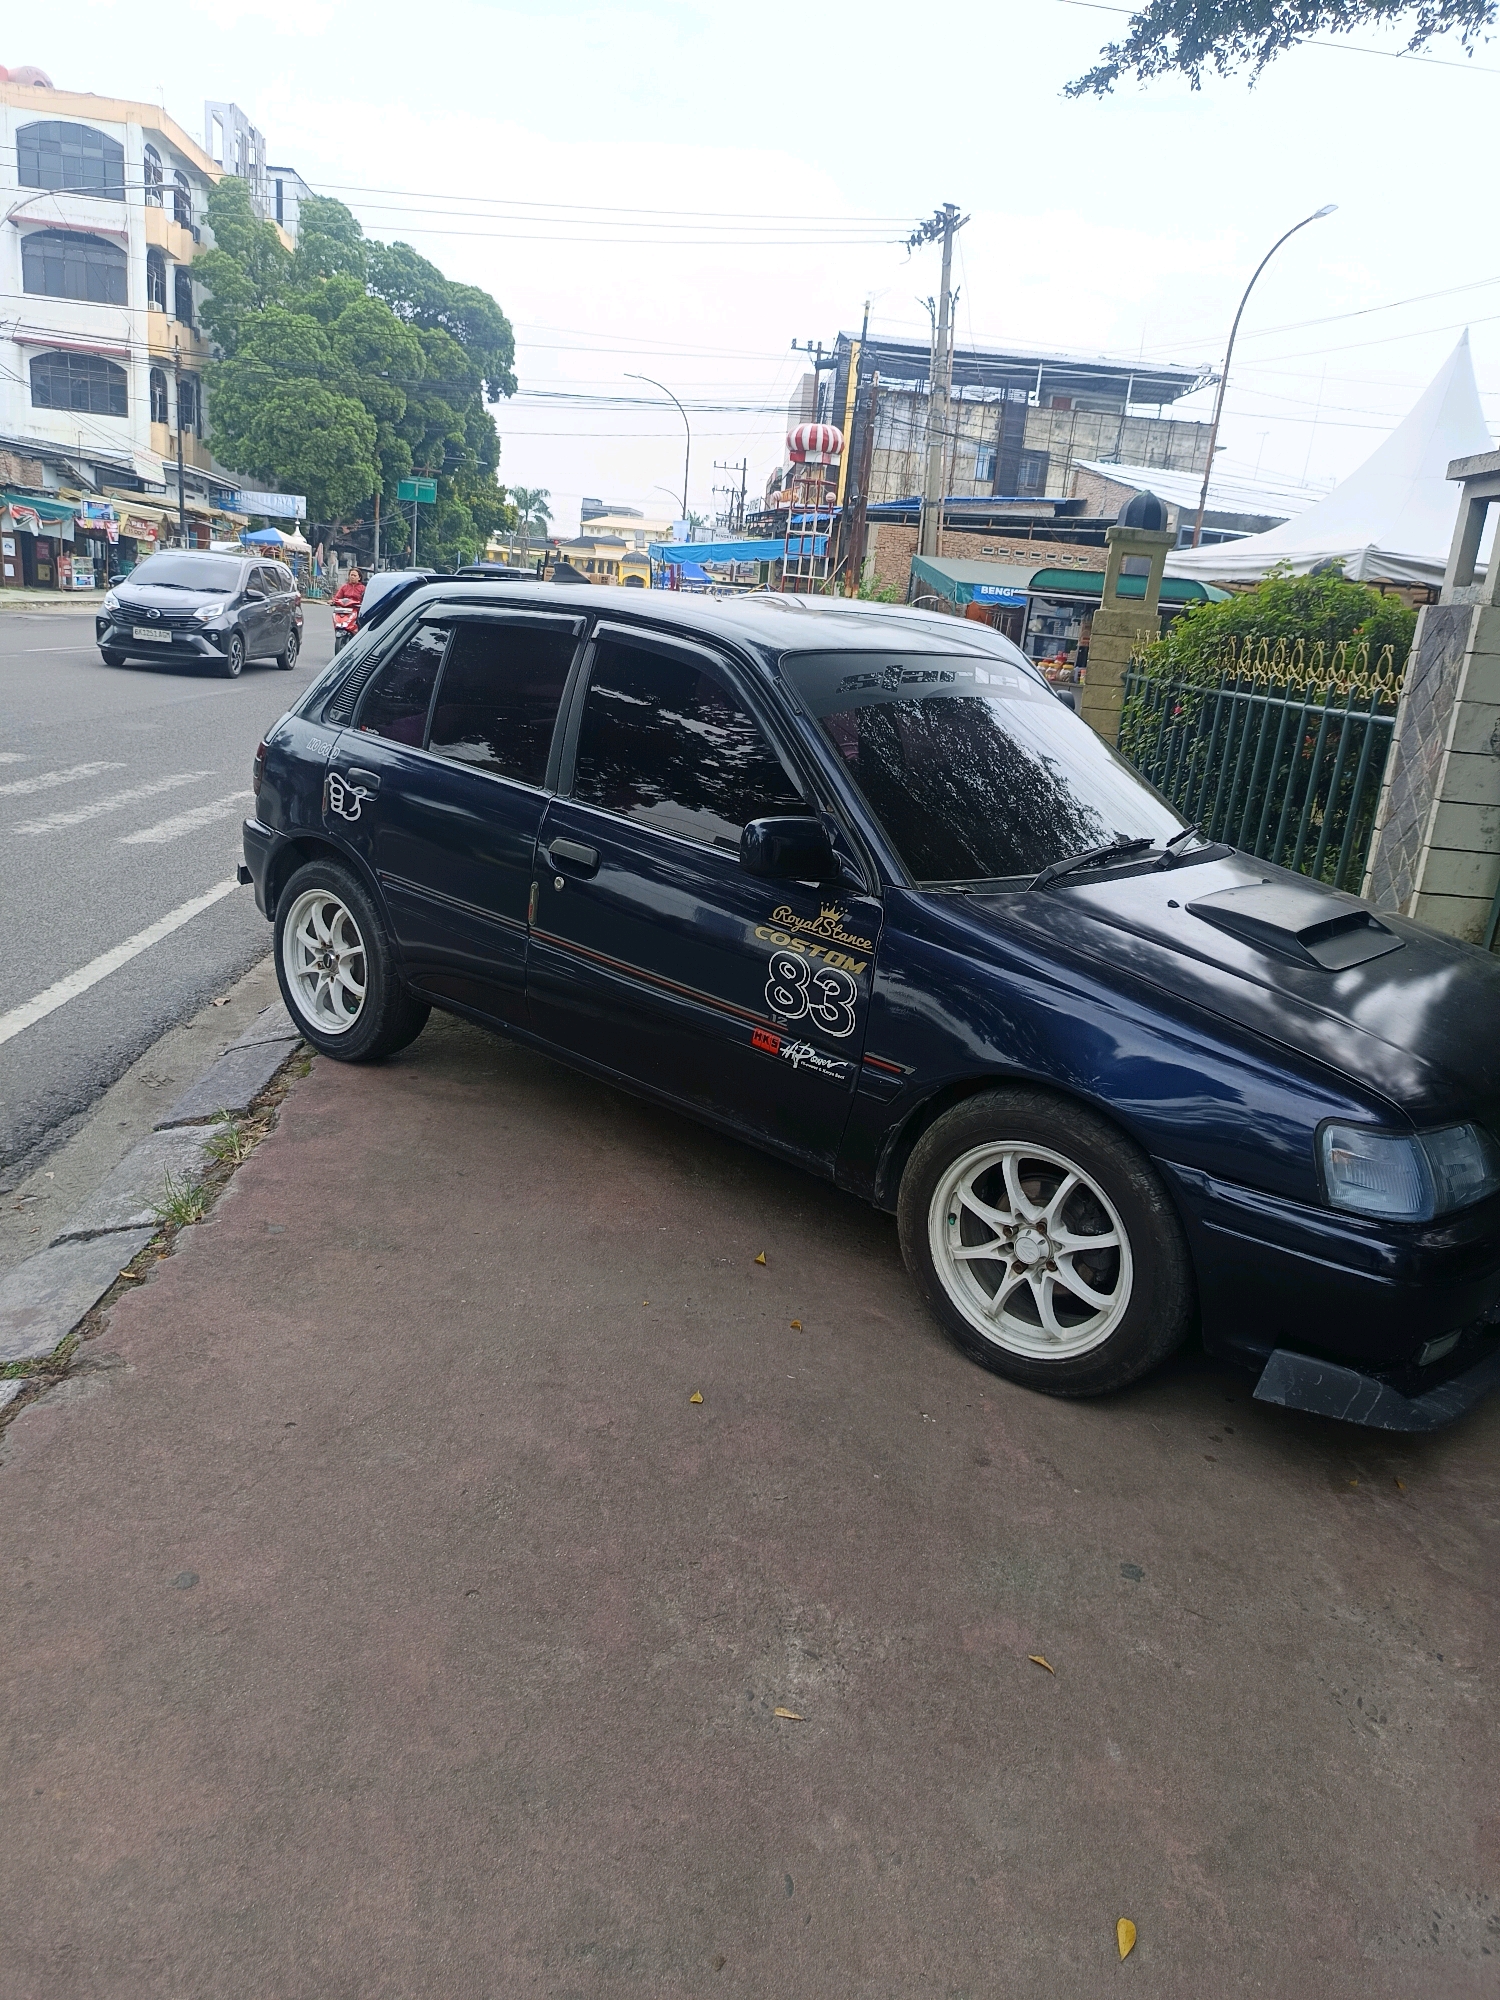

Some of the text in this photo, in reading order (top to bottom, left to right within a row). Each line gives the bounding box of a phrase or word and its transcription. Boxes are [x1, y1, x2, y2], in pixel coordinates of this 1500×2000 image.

[306, 738, 321, 752] NO
[765, 950, 857, 1037] 83
[752, 1029, 780, 1051] HKS
